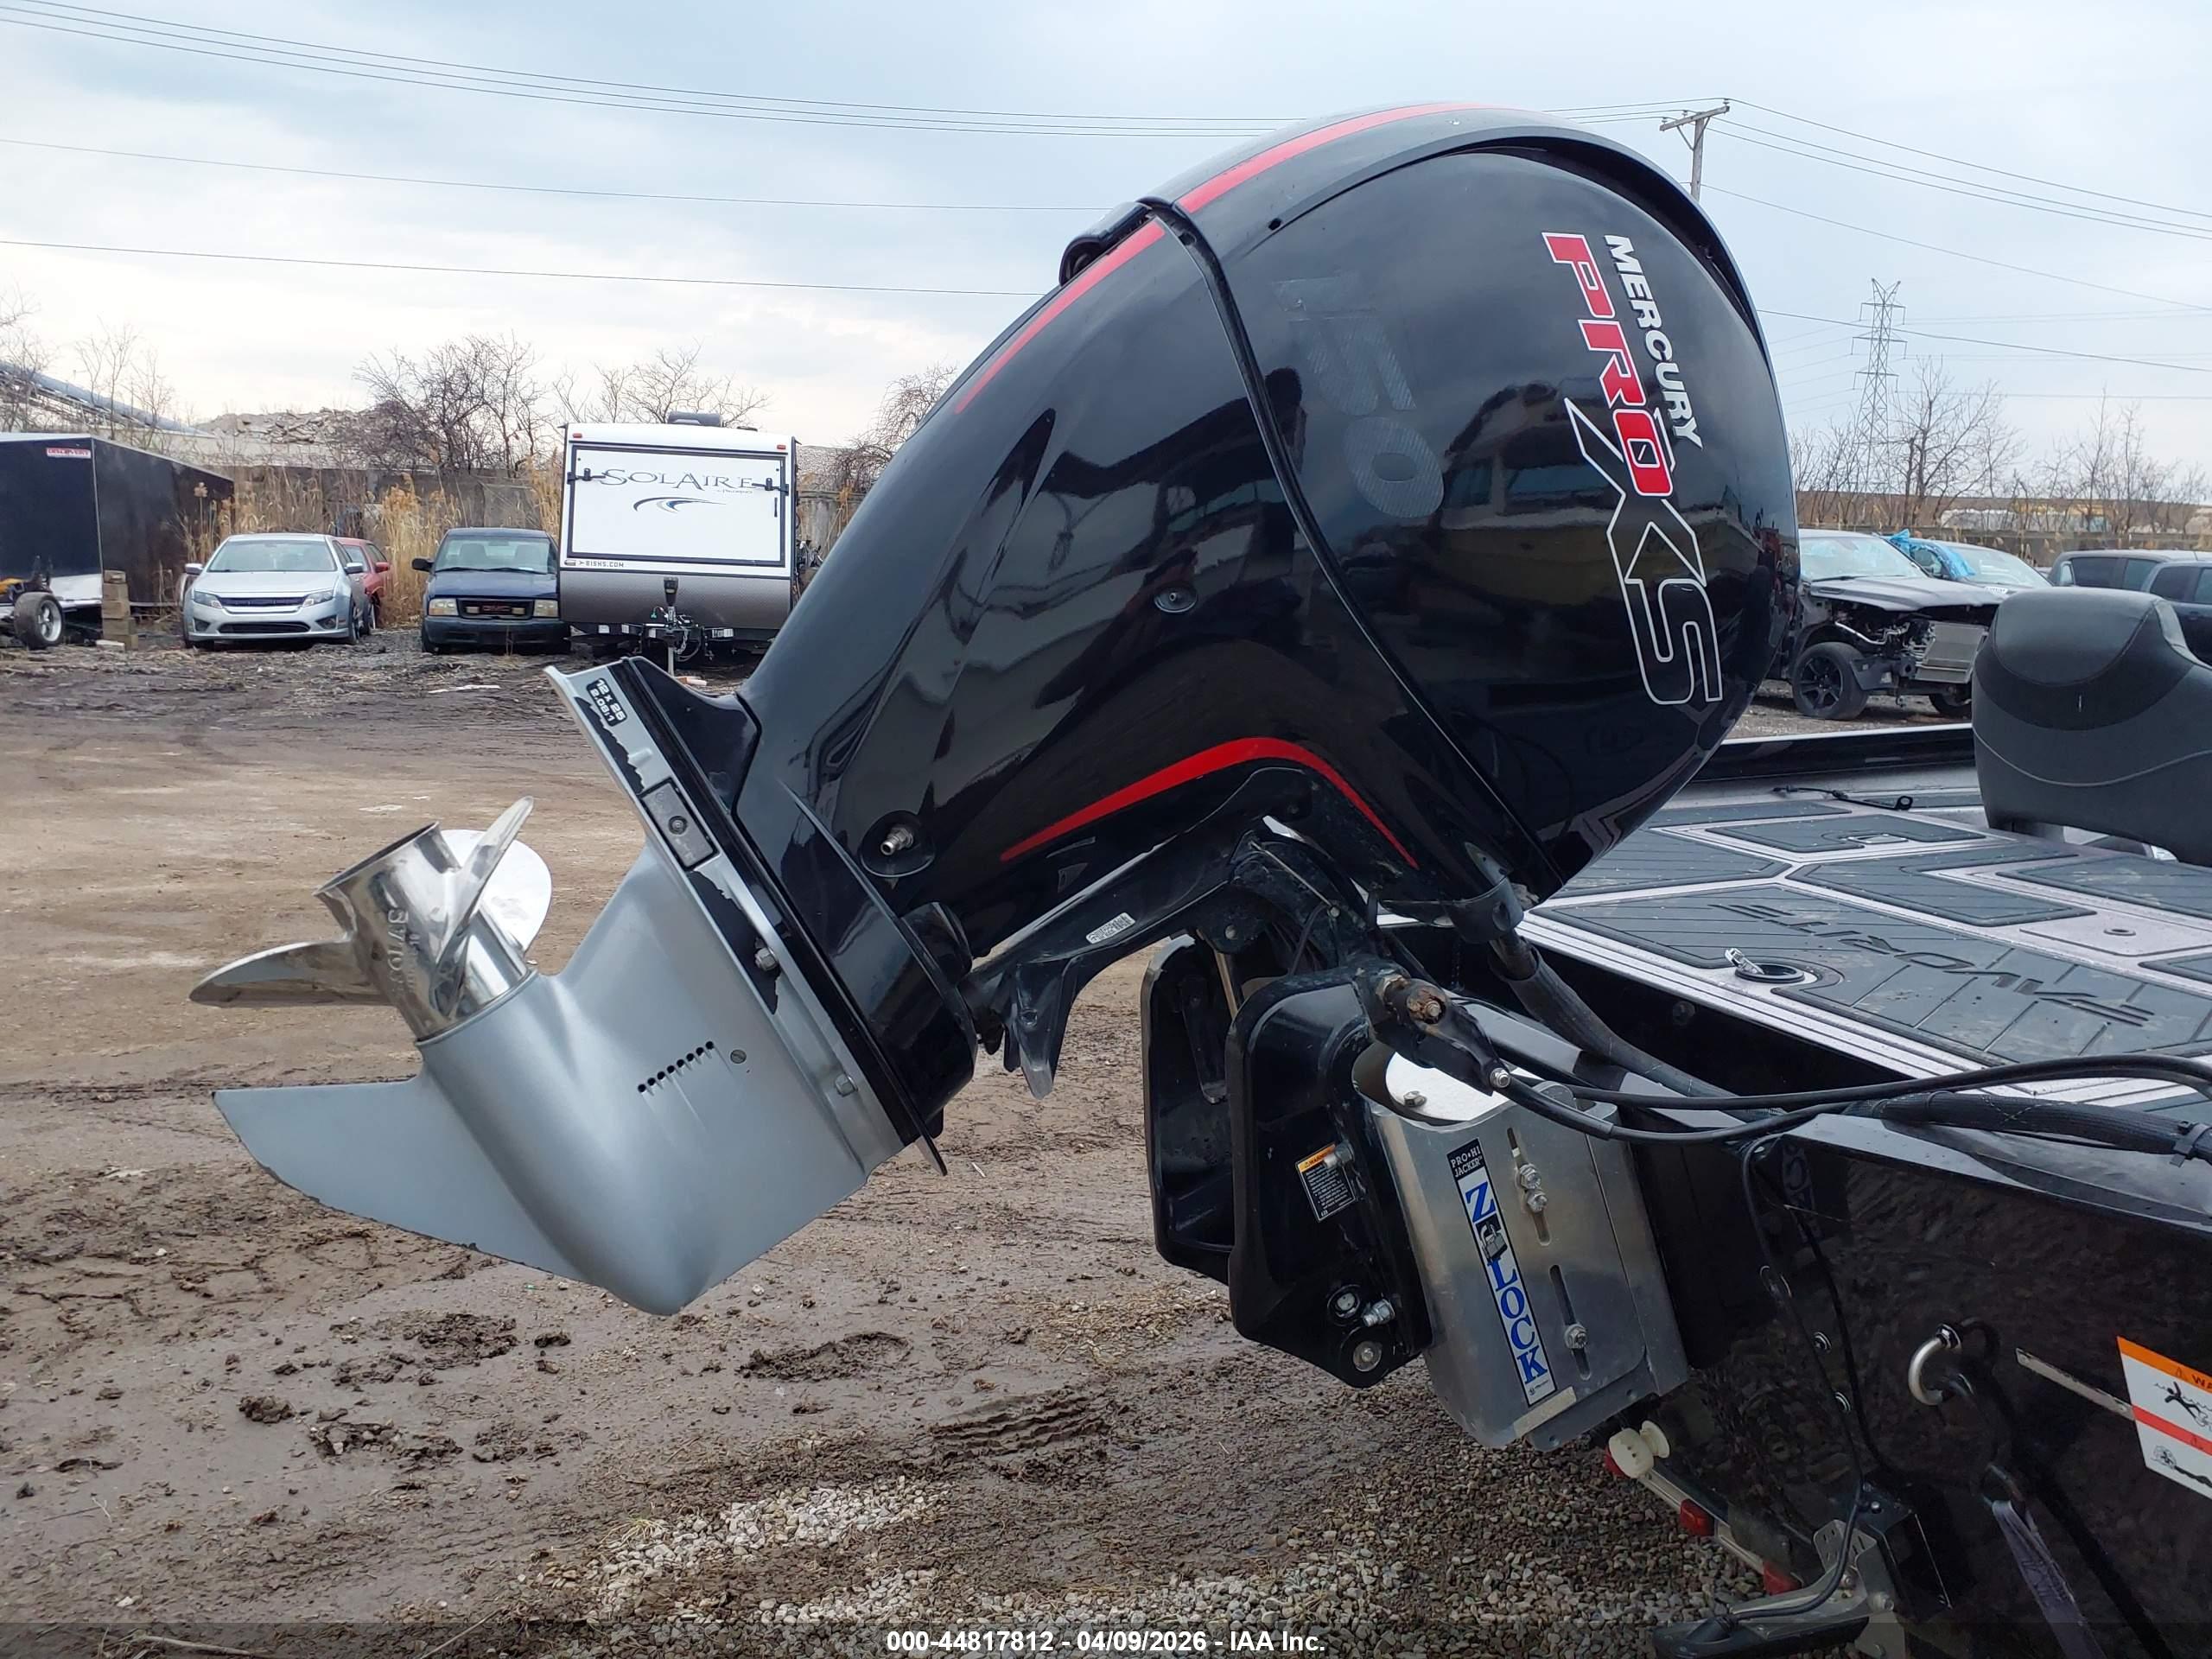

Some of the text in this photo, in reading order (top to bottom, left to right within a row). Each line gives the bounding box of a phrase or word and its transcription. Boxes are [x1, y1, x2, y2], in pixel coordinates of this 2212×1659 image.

[1605, 234, 1703, 450] MERCURY
[1541, 232, 1723, 706] PRO XS
[597, 679, 609, 695] 12
[1465, 1181, 1497, 1224] Z
[1487, 1257, 1548, 1386] LOCK
